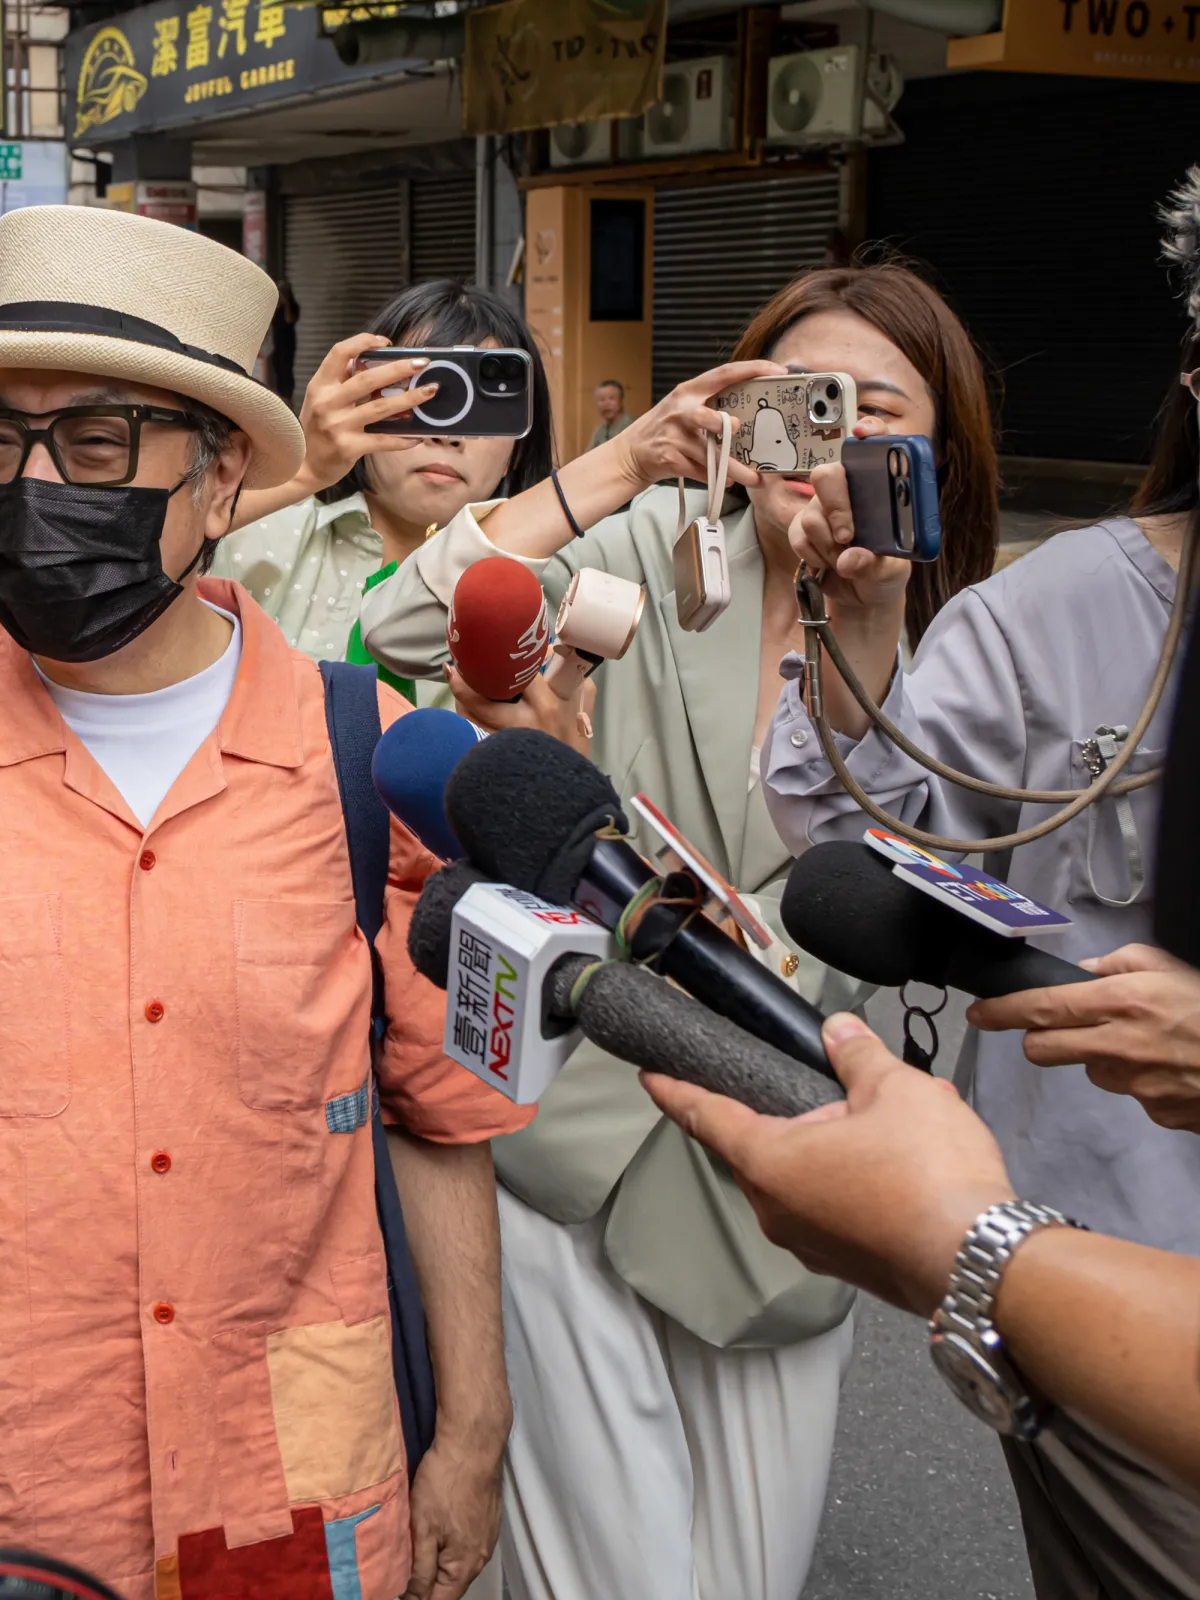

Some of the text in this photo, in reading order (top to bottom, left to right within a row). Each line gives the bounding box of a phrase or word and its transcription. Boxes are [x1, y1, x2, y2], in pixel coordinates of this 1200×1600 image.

[1059, 0, 1150, 38] TWO
[184, 59, 295, 104] JOYFUL GARAGE
[452, 928, 493, 1065] 壹新聞
[488, 953, 519, 1082] NEXTTV
